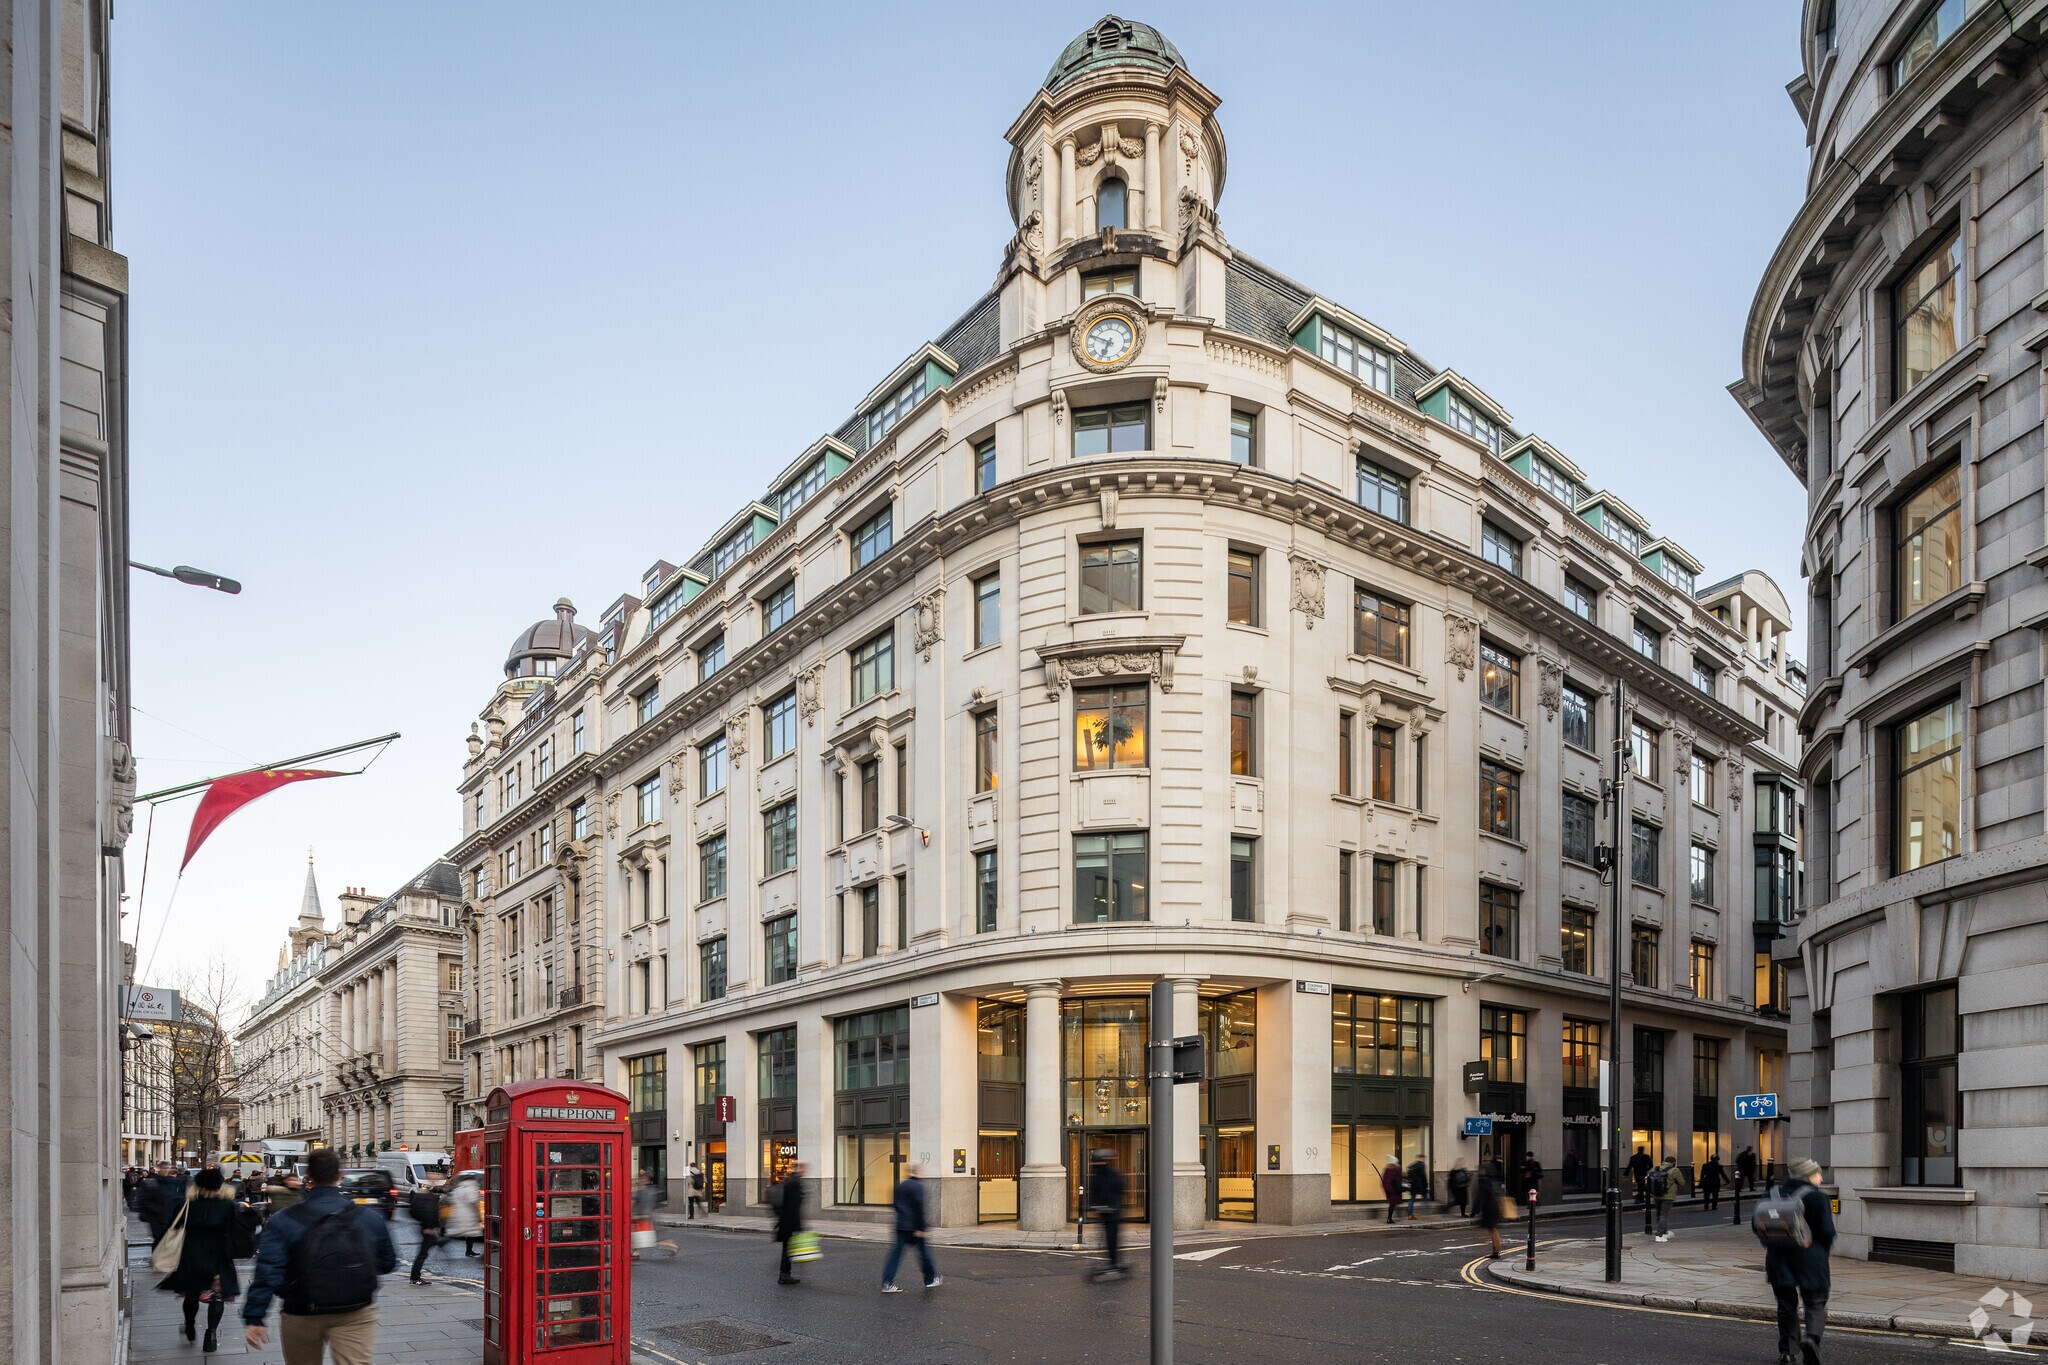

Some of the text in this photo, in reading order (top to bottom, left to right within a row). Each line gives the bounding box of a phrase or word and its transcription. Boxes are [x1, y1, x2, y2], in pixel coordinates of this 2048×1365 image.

[529, 1107, 613, 1120] TELEPHONE
[920, 1151, 931, 1165] 99
[1306, 1146, 1319, 1160] 99
